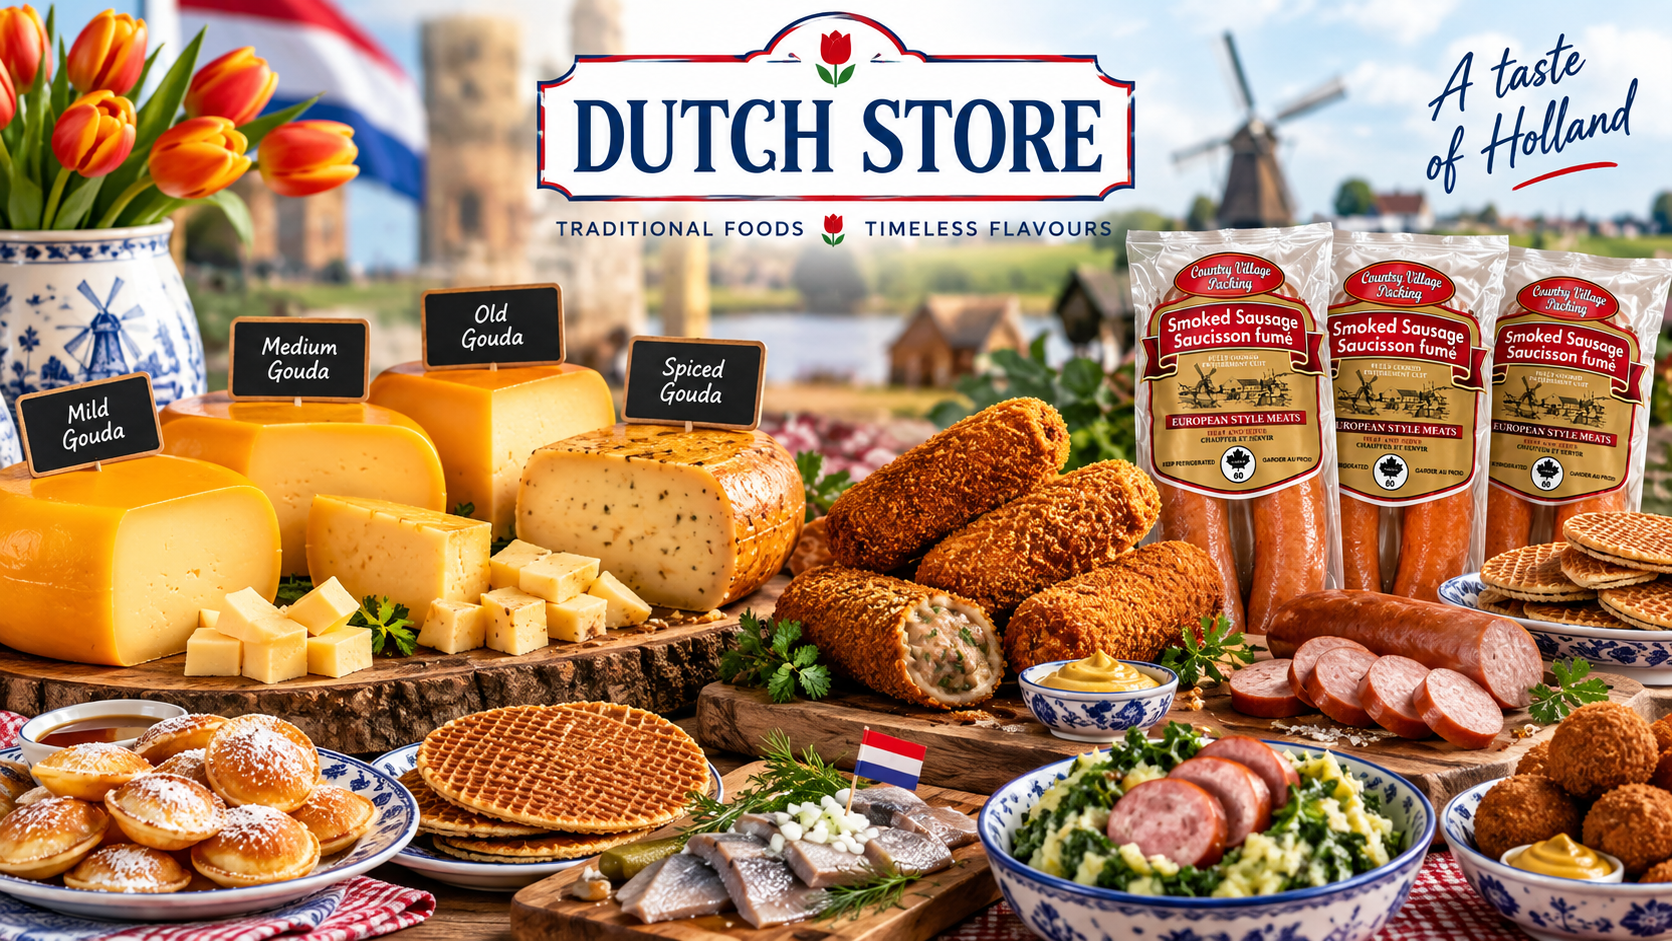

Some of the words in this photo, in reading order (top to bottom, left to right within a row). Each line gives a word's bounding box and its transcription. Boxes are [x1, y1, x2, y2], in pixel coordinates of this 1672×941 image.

[1406, 270, 1442, 291] Village
[1573, 286, 1607, 307] Village
[474, 303, 507, 323] Old
[1168, 308, 1230, 332] Smoked
[1236, 309, 1298, 331] Sausage
[461, 328, 524, 351] Gouda
[1174, 329, 1250, 349] Saucisson
[1255, 327, 1293, 345] fumé
[1333, 317, 1397, 336] Smoked
[1402, 319, 1464, 345] Sausage
[261, 336, 338, 356] Medium
[1337, 336, 1414, 353] Saucisson
[1419, 338, 1457, 360] fumé
[1505, 327, 1562, 343] Smoked
[1566, 331, 1624, 358] Sausage
[1506, 345, 1577, 363] Saucisson
[267, 360, 330, 382] Gouda
[662, 357, 726, 382] Spiced
[660, 382, 722, 406] Gouda
[68, 397, 110, 424] Mild
[1172, 415, 1228, 426] EUROPEAN
[1231, 414, 1264, 425] STYLE
[1266, 413, 1301, 423] MEATS
[62, 424, 126, 452] Gouda
[1336, 421, 1385, 432] UROPEAN
[1388, 424, 1420, 434] STYLE
[1422, 425, 1457, 436] MEATS
[1493, 422, 1545, 436] EUROPEAN
[1547, 428, 1578, 439] STYLE
[1579, 432, 1611, 444] MEATS
